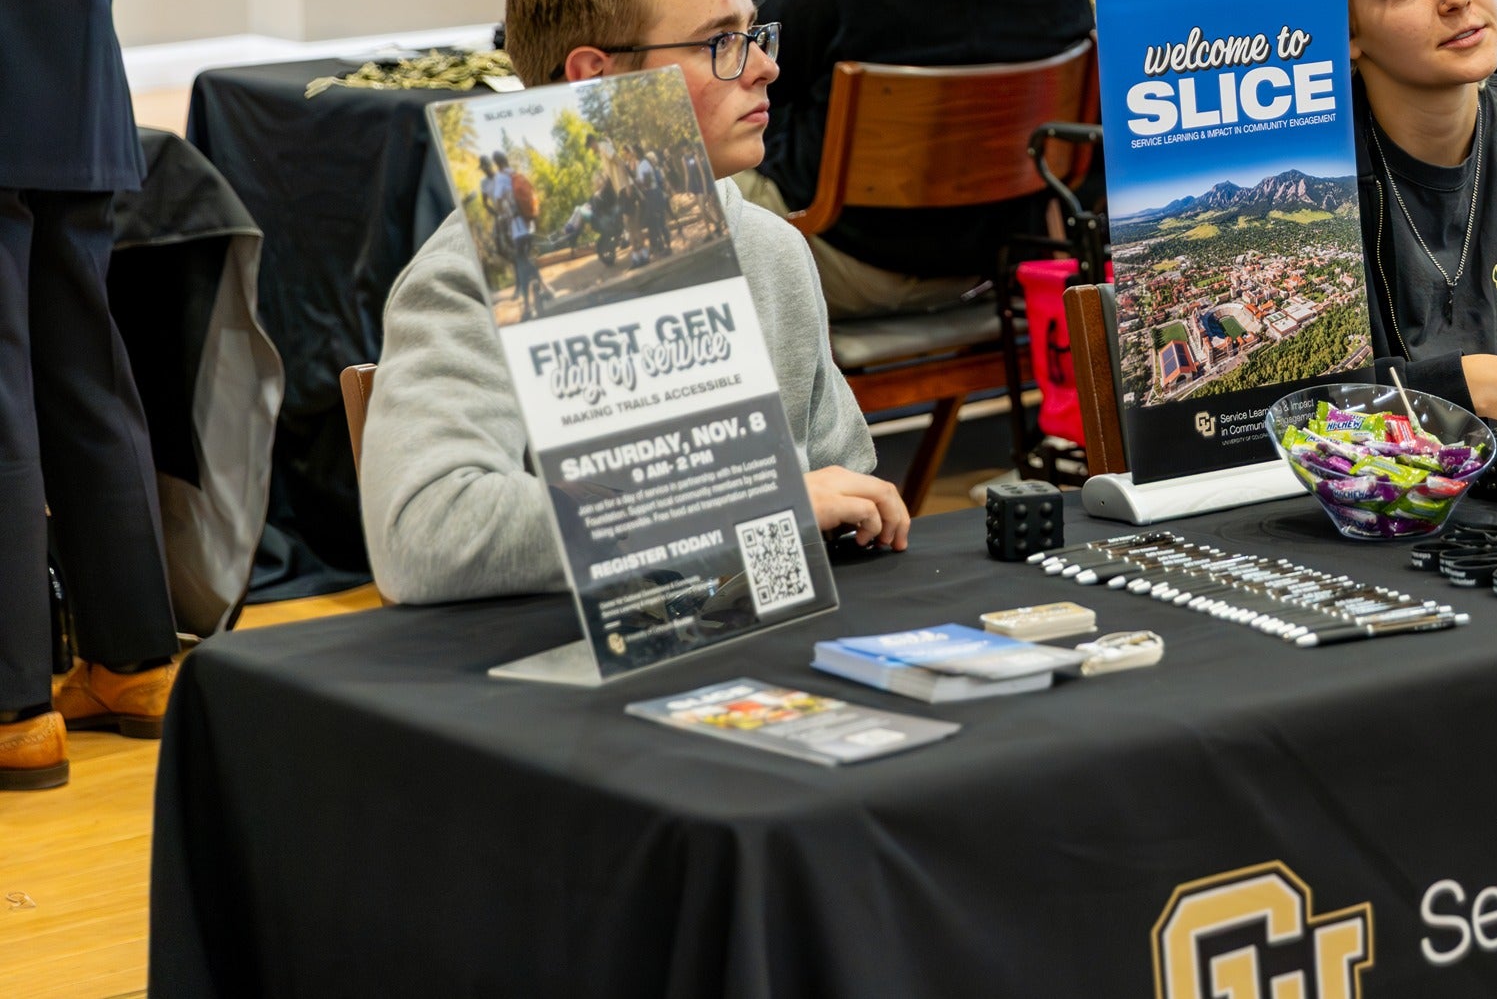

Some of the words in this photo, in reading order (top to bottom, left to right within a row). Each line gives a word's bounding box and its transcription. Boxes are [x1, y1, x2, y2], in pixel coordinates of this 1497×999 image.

[1144, 26, 1272, 77] welcome
[1276, 26, 1312, 59] to
[1127, 60, 1336, 136] SLICE
[1131, 137, 1162, 149] SERVICE
[1163, 131, 1199, 145] LEARNING
[1201, 131, 1206, 140] &
[1207, 126, 1233, 138] IMPACT
[1235, 126, 1242, 134] IN
[1243, 120, 1288, 133] COMMUNITY
[1289, 113, 1336, 128] ENGAGEMENT
[528, 323, 642, 377] FIRST
[654, 303, 736, 344] GEN
[550, 352, 607, 405] day
[607, 341, 637, 392] of
[641, 331, 731, 377] service
[561, 406, 614, 427] MAKING
[616, 394, 660, 414] TRAILS
[664, 373, 742, 402] ACCESSIBLE
[1220, 411, 1247, 423] Service
[560, 432, 690, 481] SATURDAY,
[691, 415, 746, 447] NOV.
[749, 411, 767, 432] 8
[1221, 427, 1228, 436] in
[632, 467, 644, 482] 9
[676, 456, 688, 471] 2
[690, 449, 714, 467] PM
[590, 546, 667, 579] REGISTER
[668, 529, 723, 556] TODAY!
